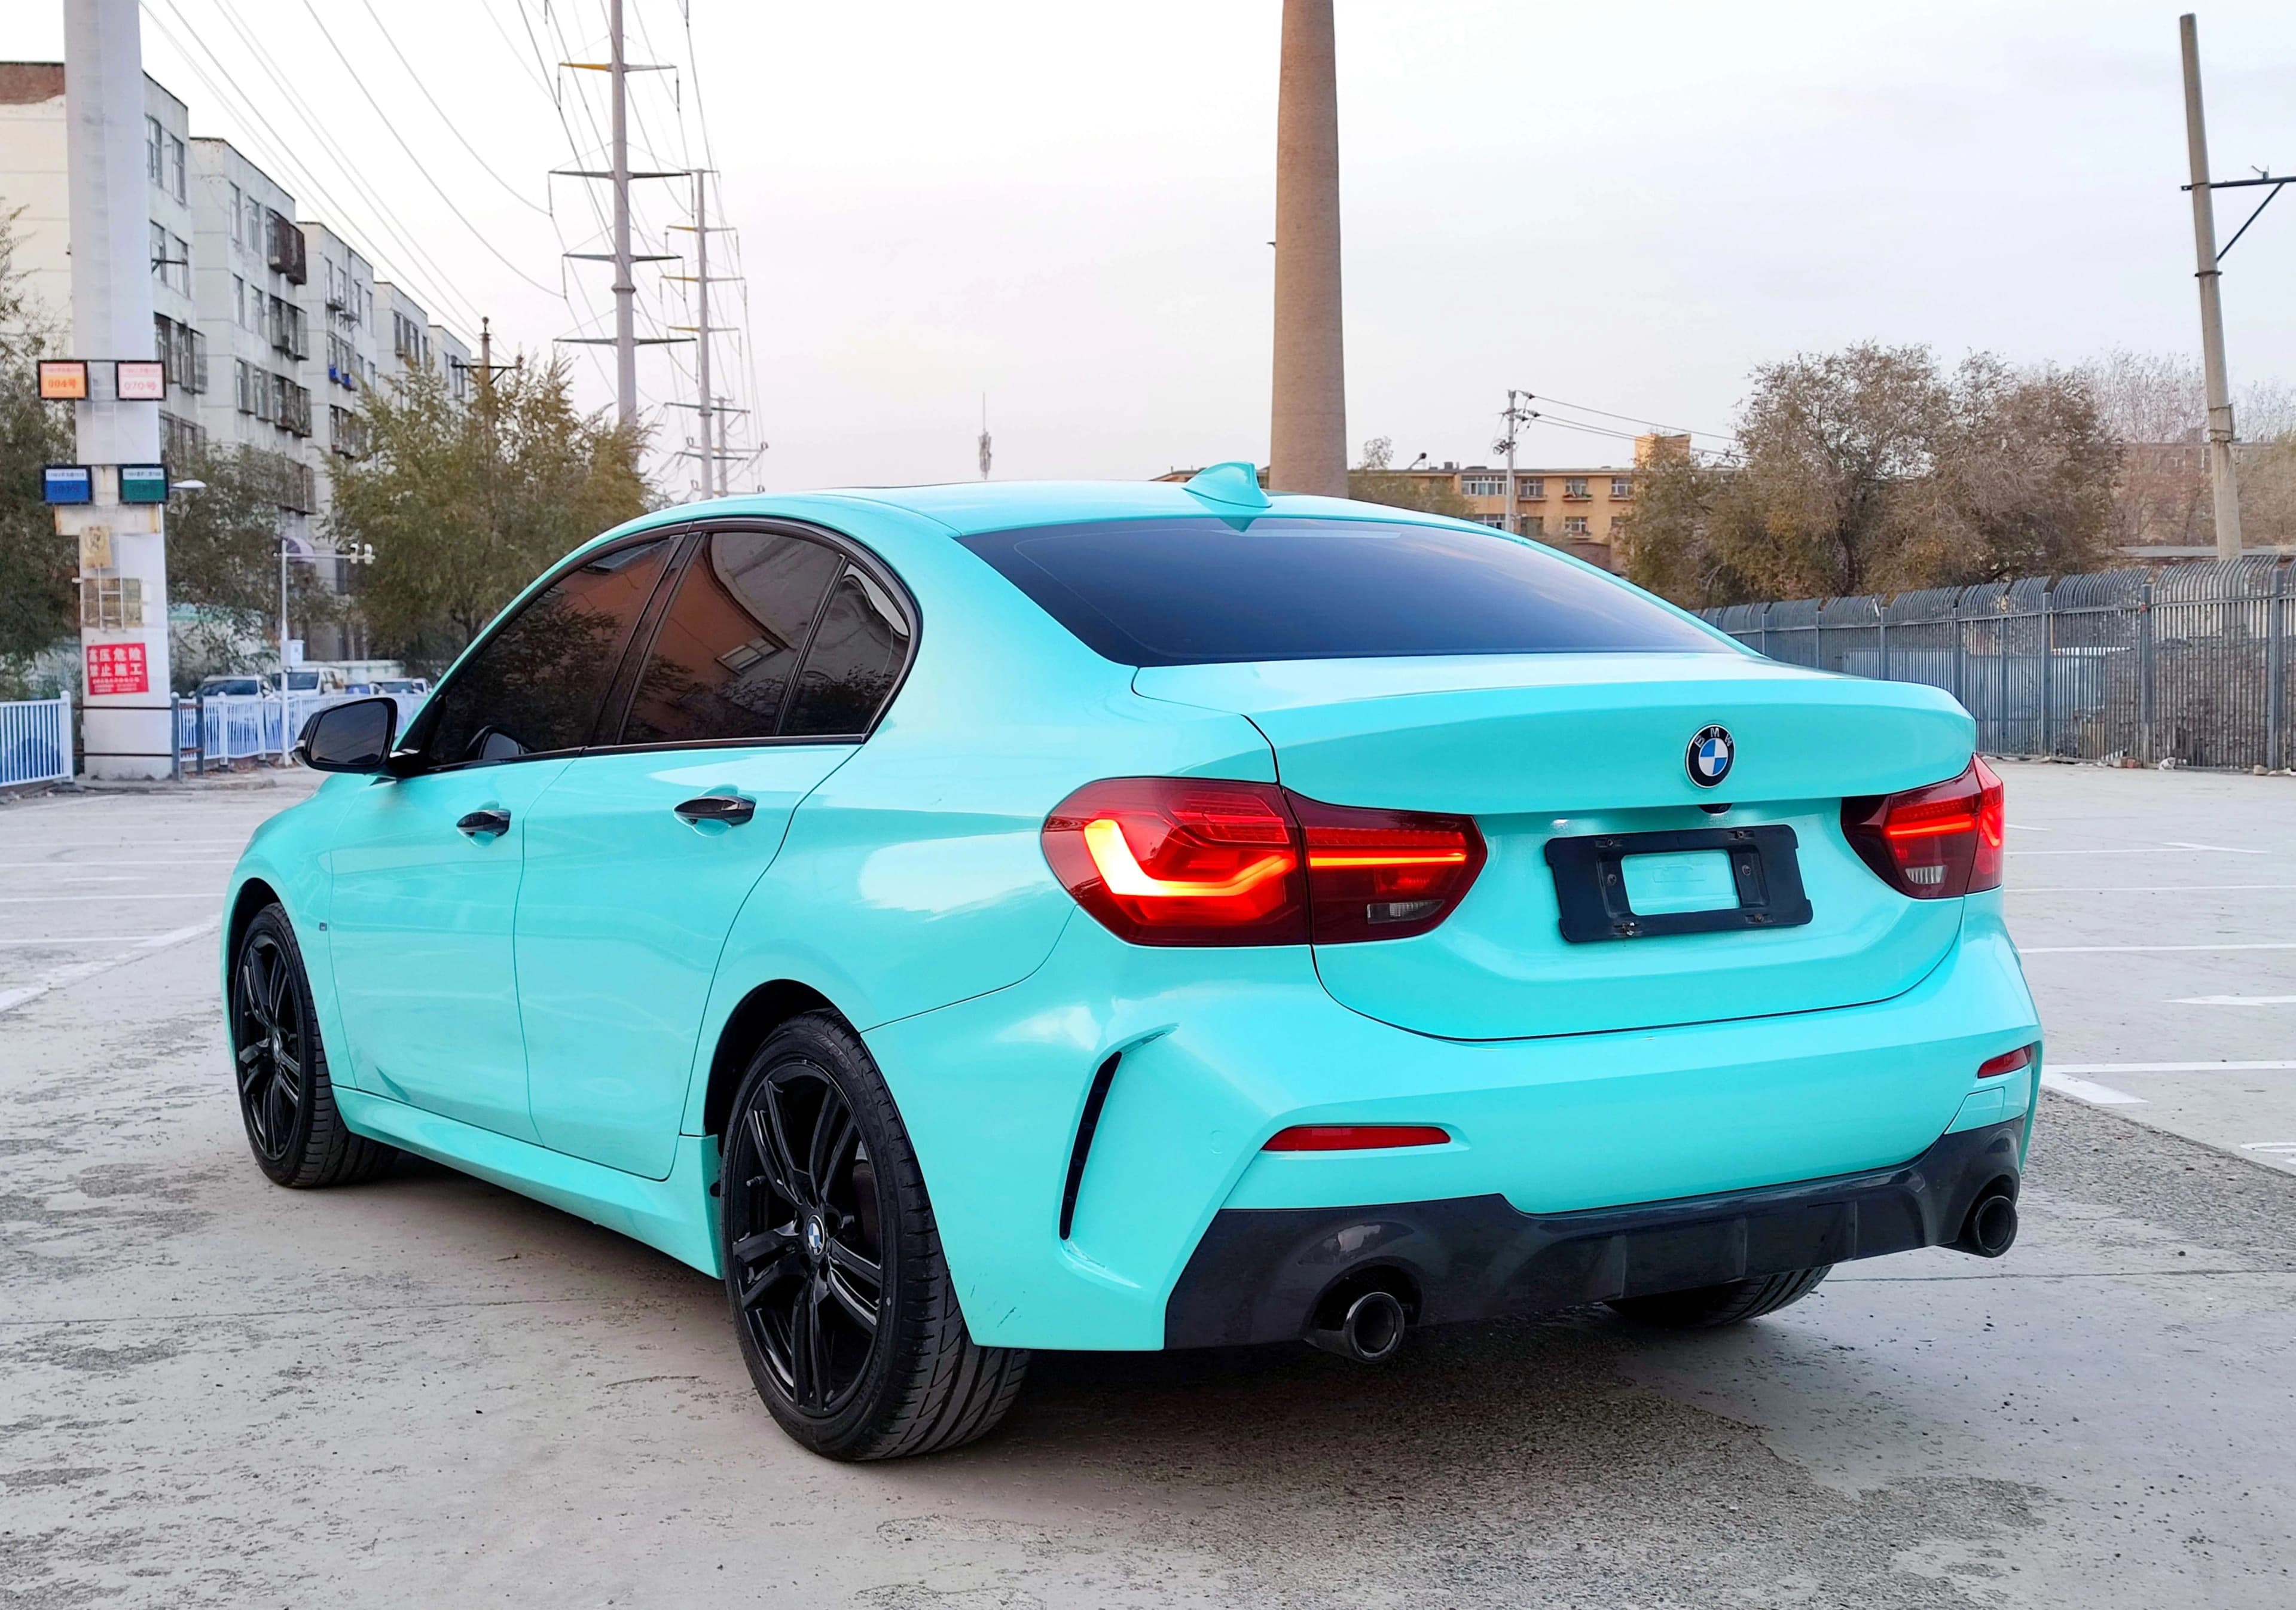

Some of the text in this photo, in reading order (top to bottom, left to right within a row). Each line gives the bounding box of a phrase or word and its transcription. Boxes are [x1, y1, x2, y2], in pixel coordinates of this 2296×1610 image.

[88, 647, 141, 662] 高压危险
[90, 662, 143, 677] 禁止施工
[1694, 727, 1732, 748] BMW
